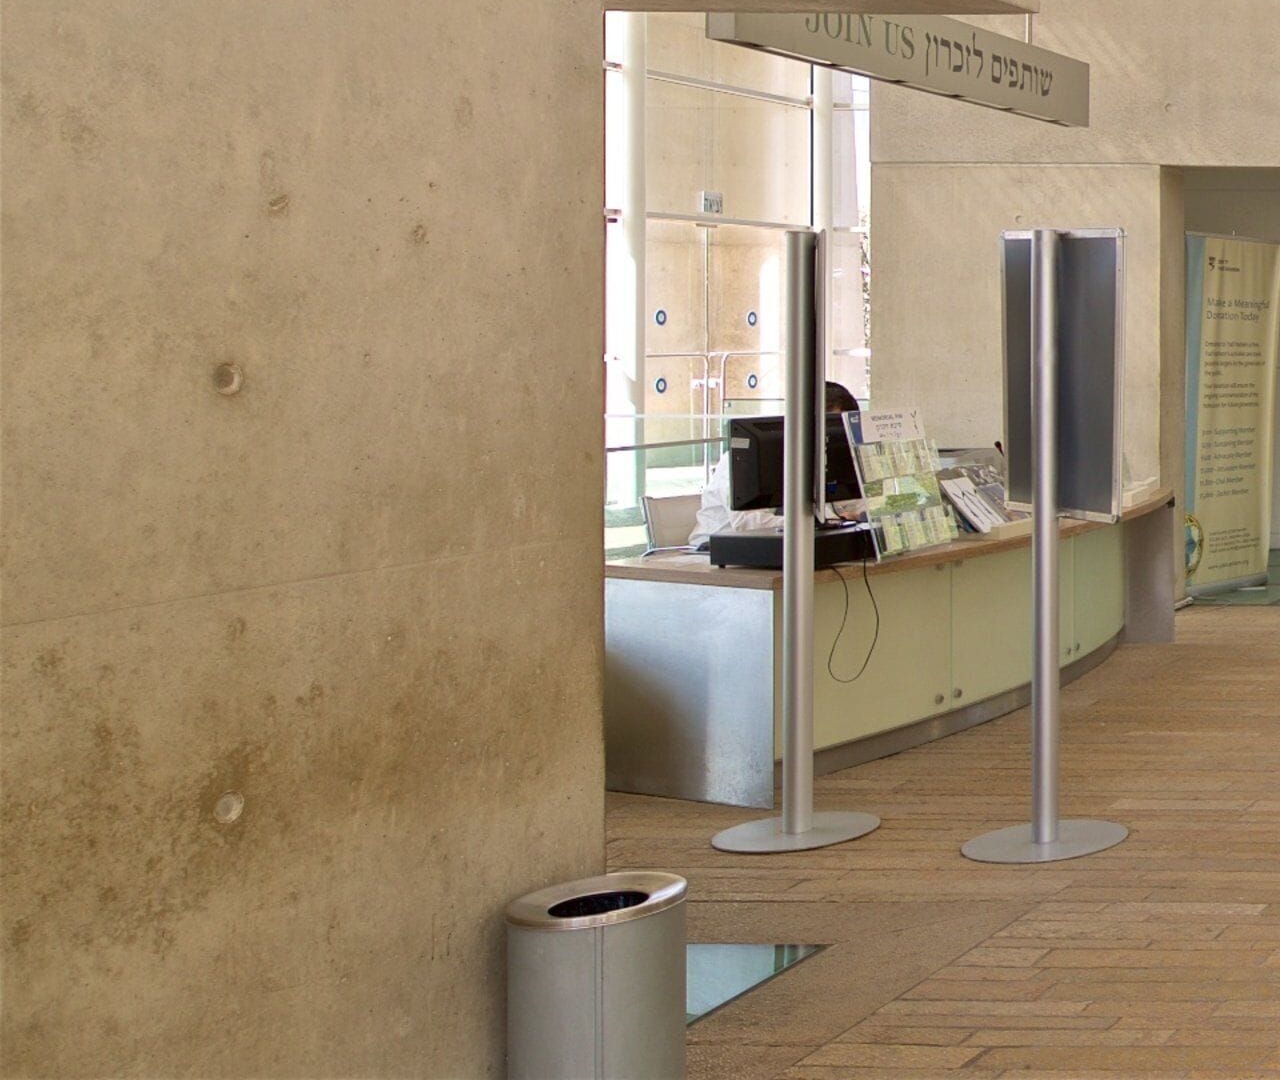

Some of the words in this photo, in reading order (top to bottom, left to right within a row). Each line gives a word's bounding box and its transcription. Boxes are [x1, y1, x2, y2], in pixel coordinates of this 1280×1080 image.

[805, 12, 873, 48] JOIN
[884, 20, 915, 60] US
[925, 31, 983, 77] לזכרון
[992, 53, 1053, 97] שותפים
